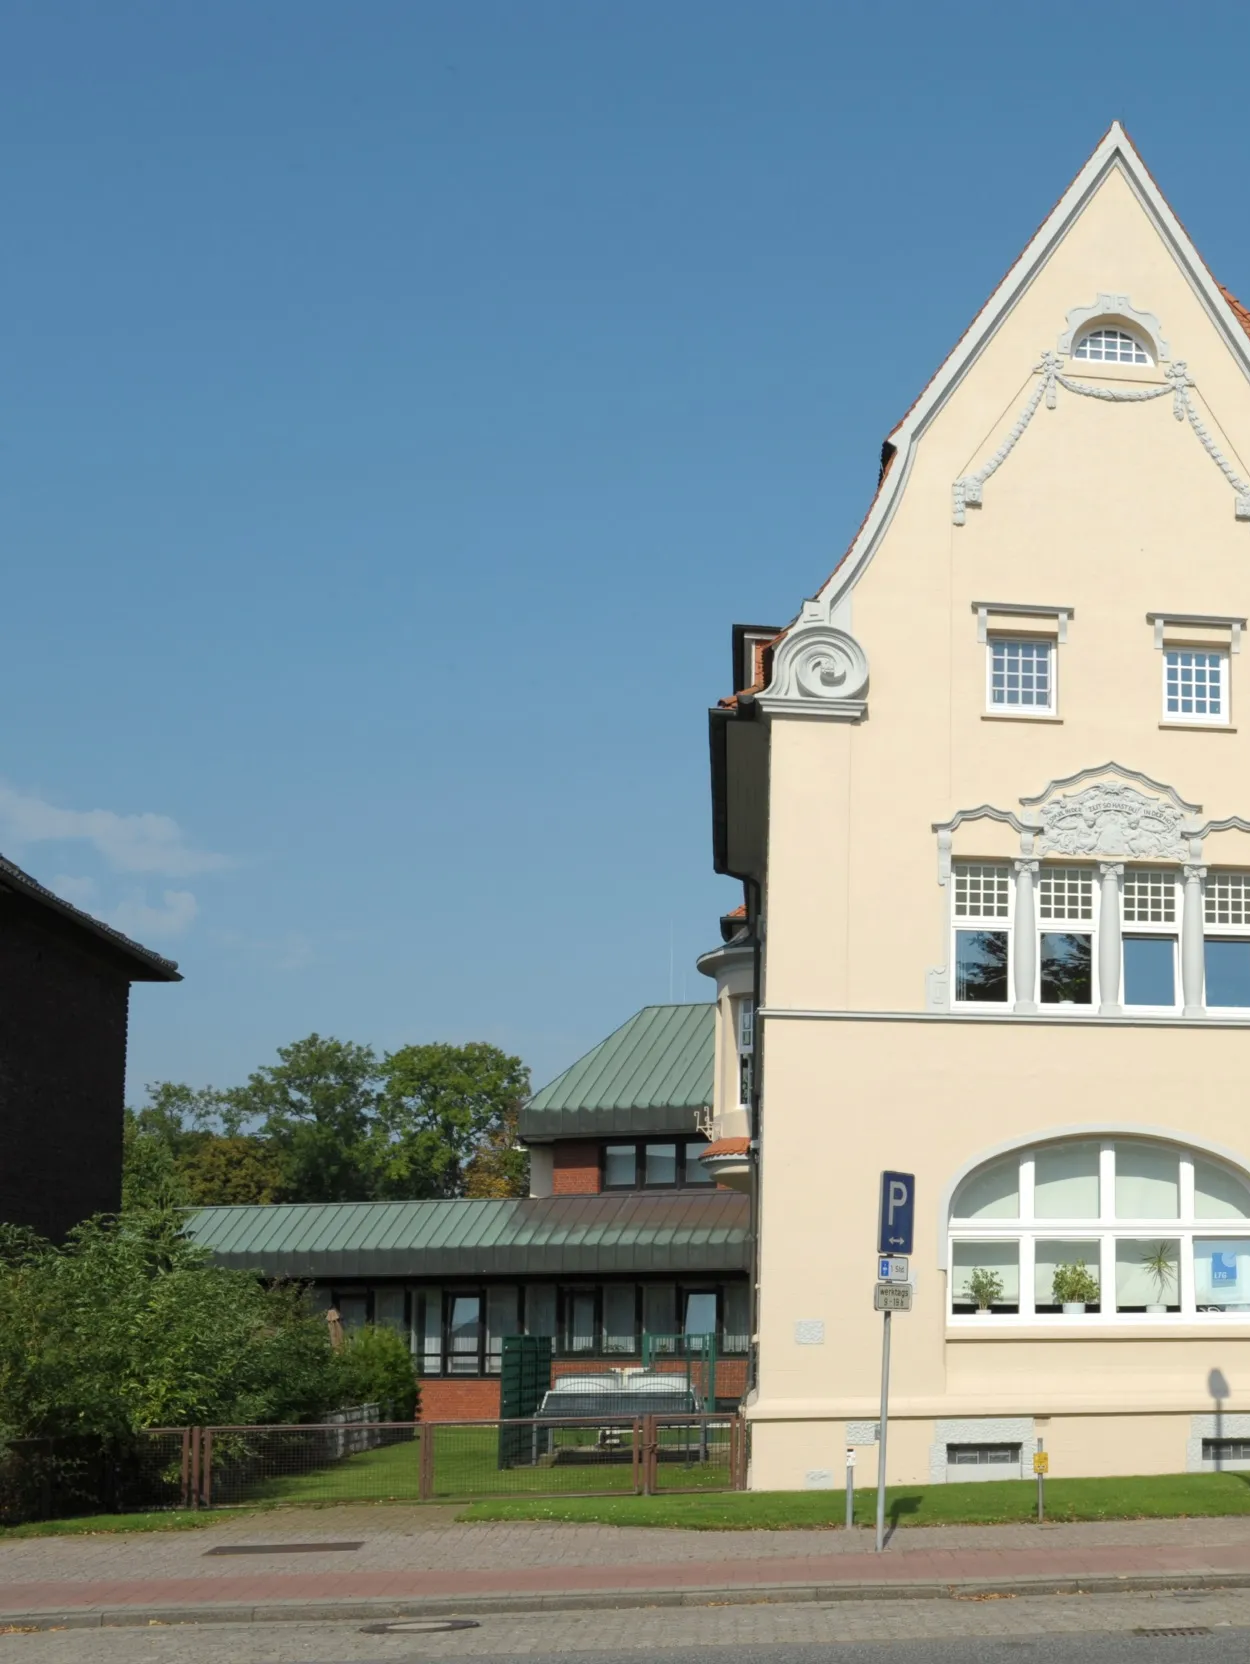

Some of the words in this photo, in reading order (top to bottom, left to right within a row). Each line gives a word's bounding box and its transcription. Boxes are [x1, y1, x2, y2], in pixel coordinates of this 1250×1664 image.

[888, 1180, 907, 1226] P
[1214, 1271, 1228, 1279] LTG
[880, 1288, 909, 1299] werktags
